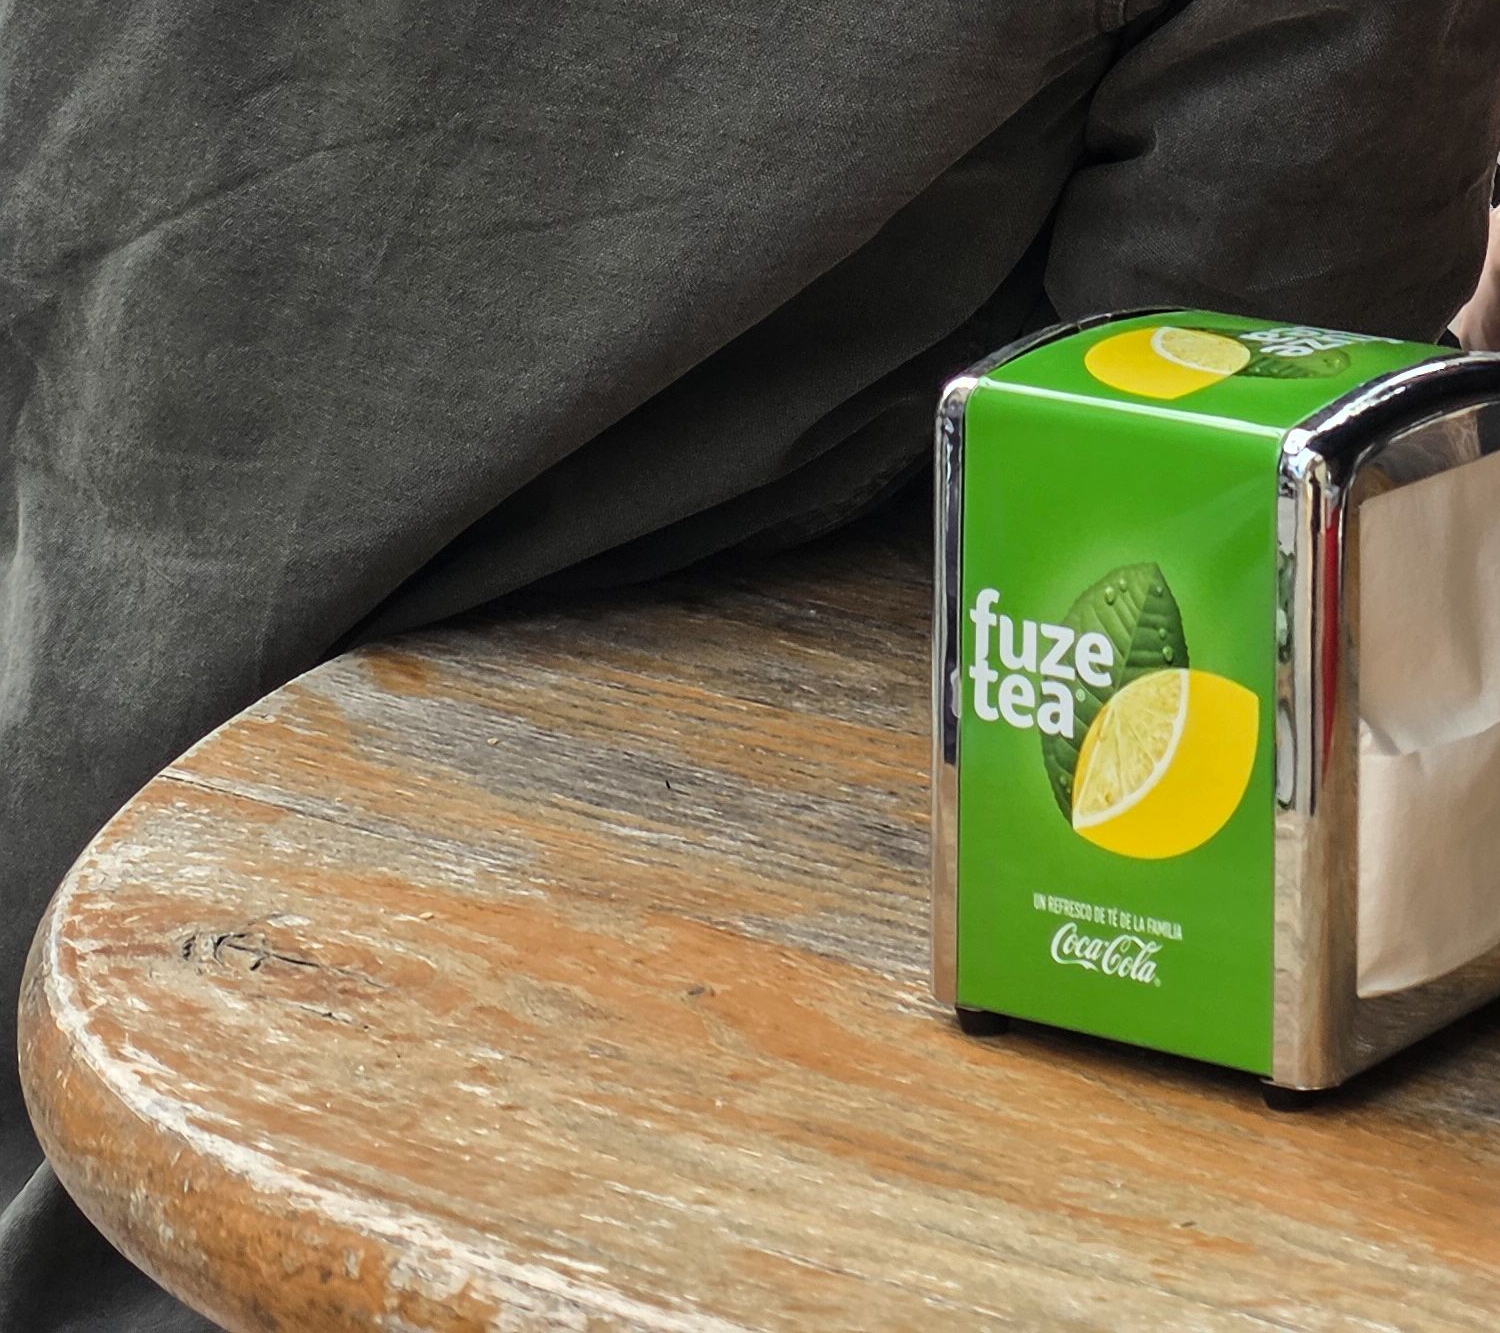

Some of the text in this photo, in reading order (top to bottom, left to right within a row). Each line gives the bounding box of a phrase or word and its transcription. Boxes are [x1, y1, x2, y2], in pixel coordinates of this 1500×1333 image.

[969, 587, 1114, 687] fuze
[969, 658, 1074, 739] tea
[1033, 892, 1183, 941] UN REFRESCO DE TÉ DE LA FAMILIA
